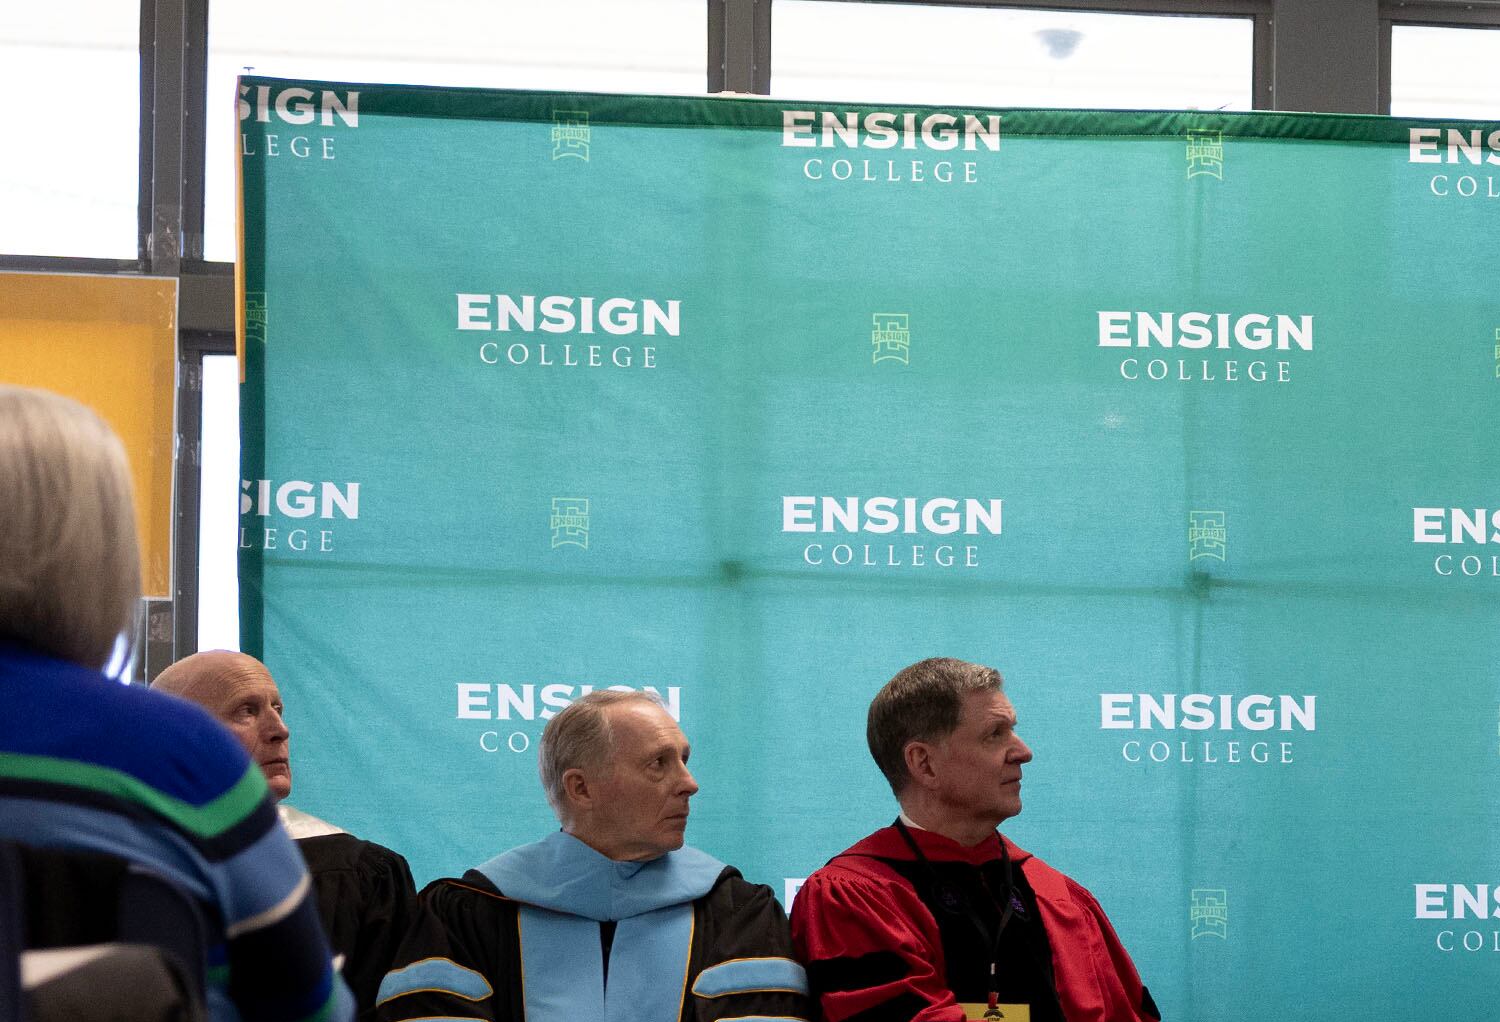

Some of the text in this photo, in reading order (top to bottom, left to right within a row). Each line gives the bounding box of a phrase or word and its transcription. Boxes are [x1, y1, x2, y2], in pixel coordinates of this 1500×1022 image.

[782, 110, 1002, 152] ENSIGN
[241, 133, 336, 160] LEGE
[803, 158, 977, 183] COLLEGE
[455, 293, 682, 337] ENSIGN
[1097, 311, 1314, 350] ENSIGN
[479, 342, 657, 369] COLLEGE
[1120, 358, 1291, 382] COLLEGE
[782, 496, 1003, 535] ENSIGN
[240, 527, 334, 552] LEGE
[803, 543, 979, 567] COLLEGE
[1100, 693, 1317, 731] ENSIGN
[1122, 740, 1293, 763] COLLEGE
